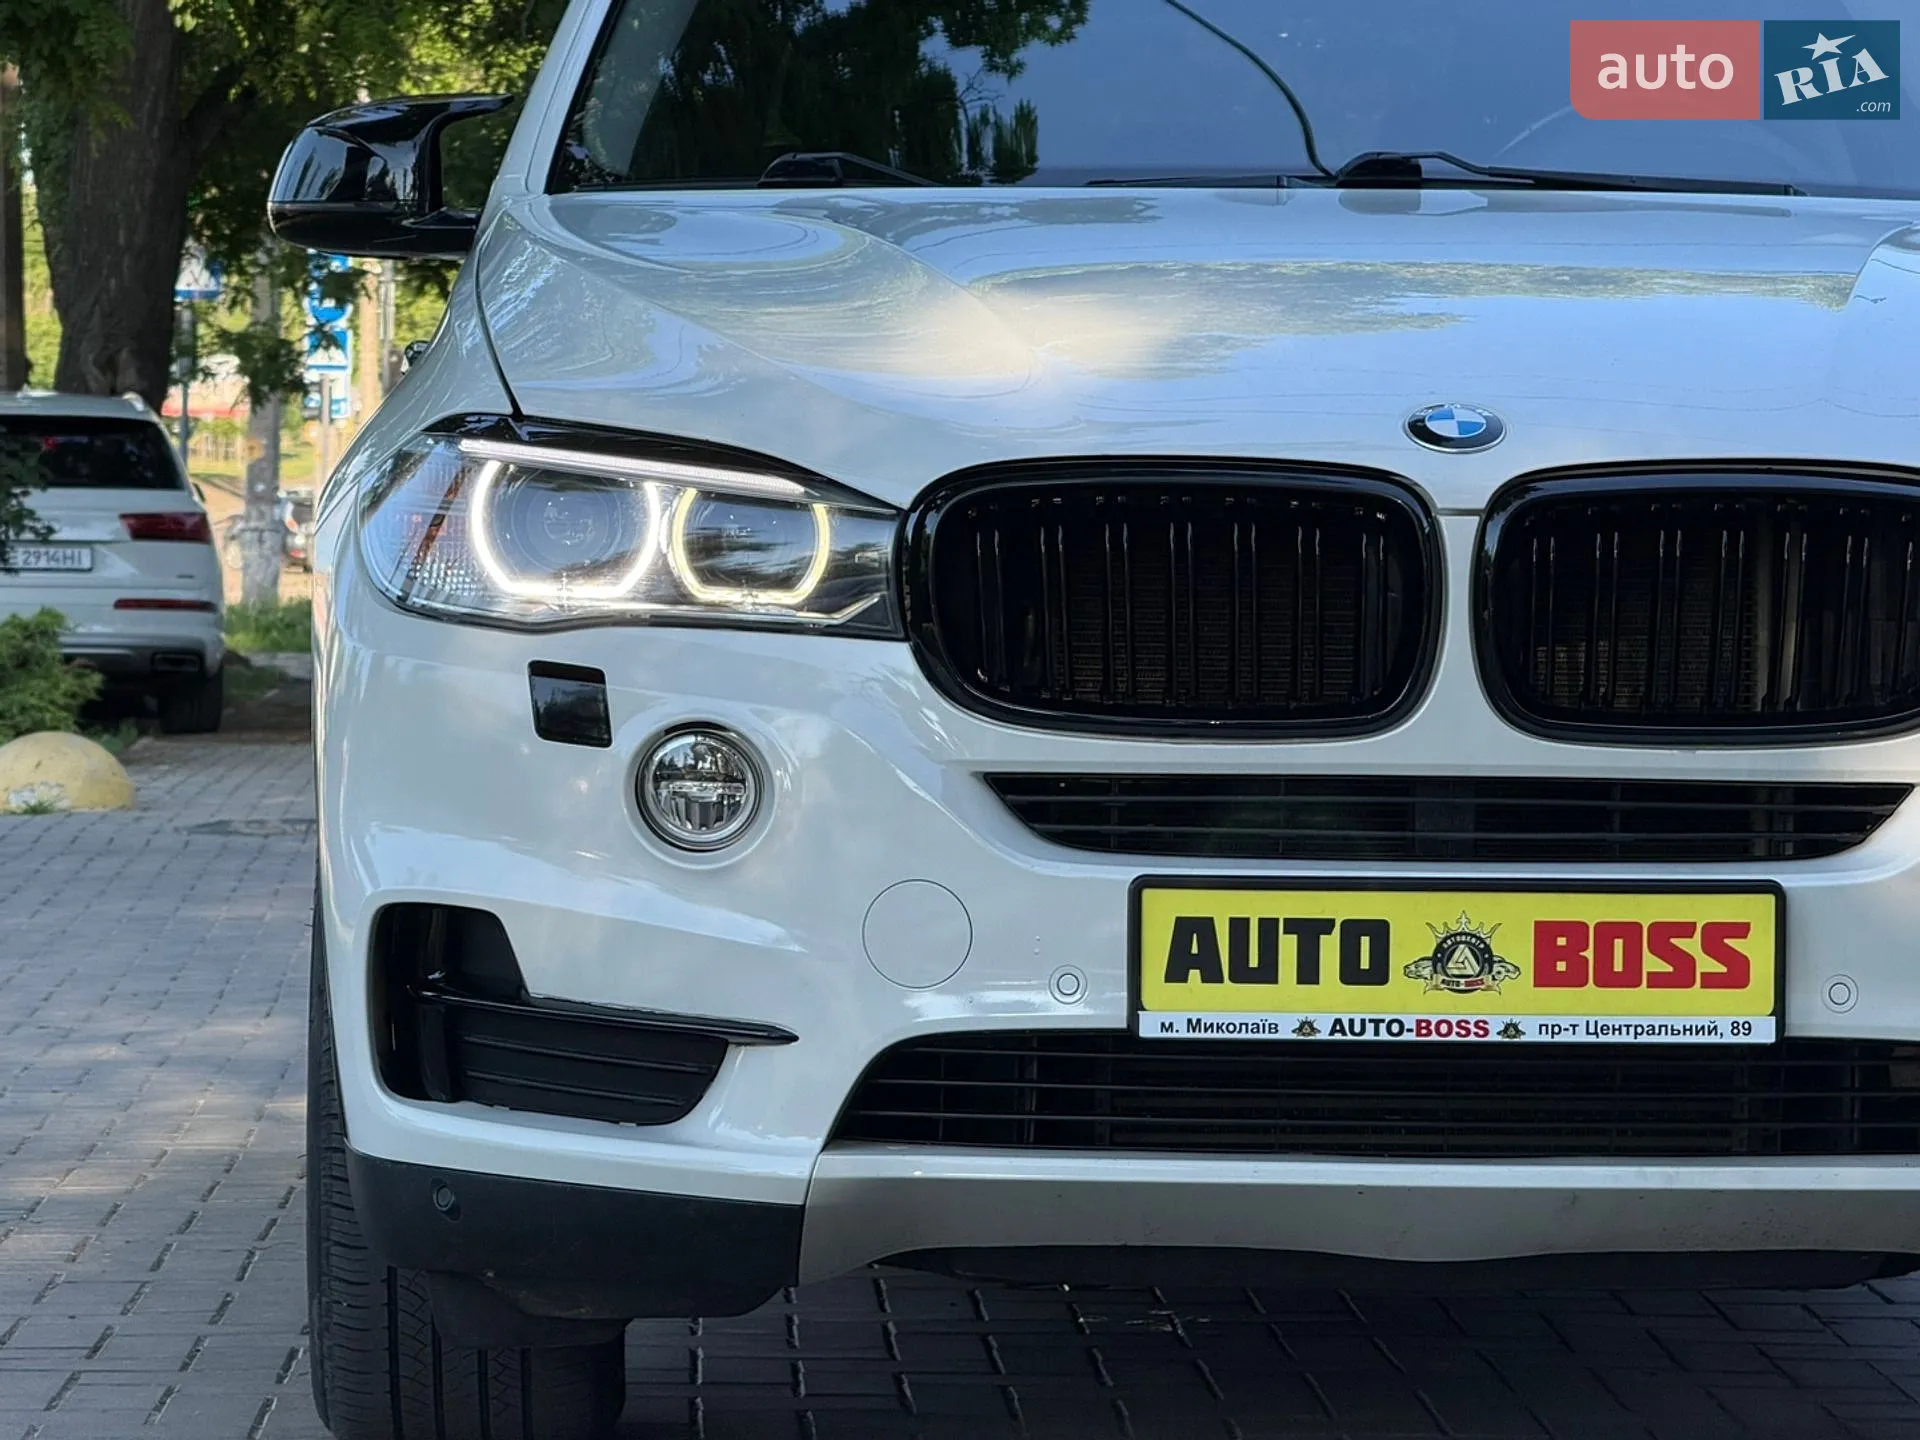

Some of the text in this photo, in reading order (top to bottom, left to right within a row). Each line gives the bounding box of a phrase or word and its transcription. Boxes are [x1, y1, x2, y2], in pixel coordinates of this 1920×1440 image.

[1164, 916, 1751, 989] AUTO BOSS
[1160, 1018, 1279, 1035] м. Миколаїв
[1328, 1018, 1490, 1038] AUTO-BOSS
[1538, 1020, 1752, 1040] пр-т Центральний, 89
